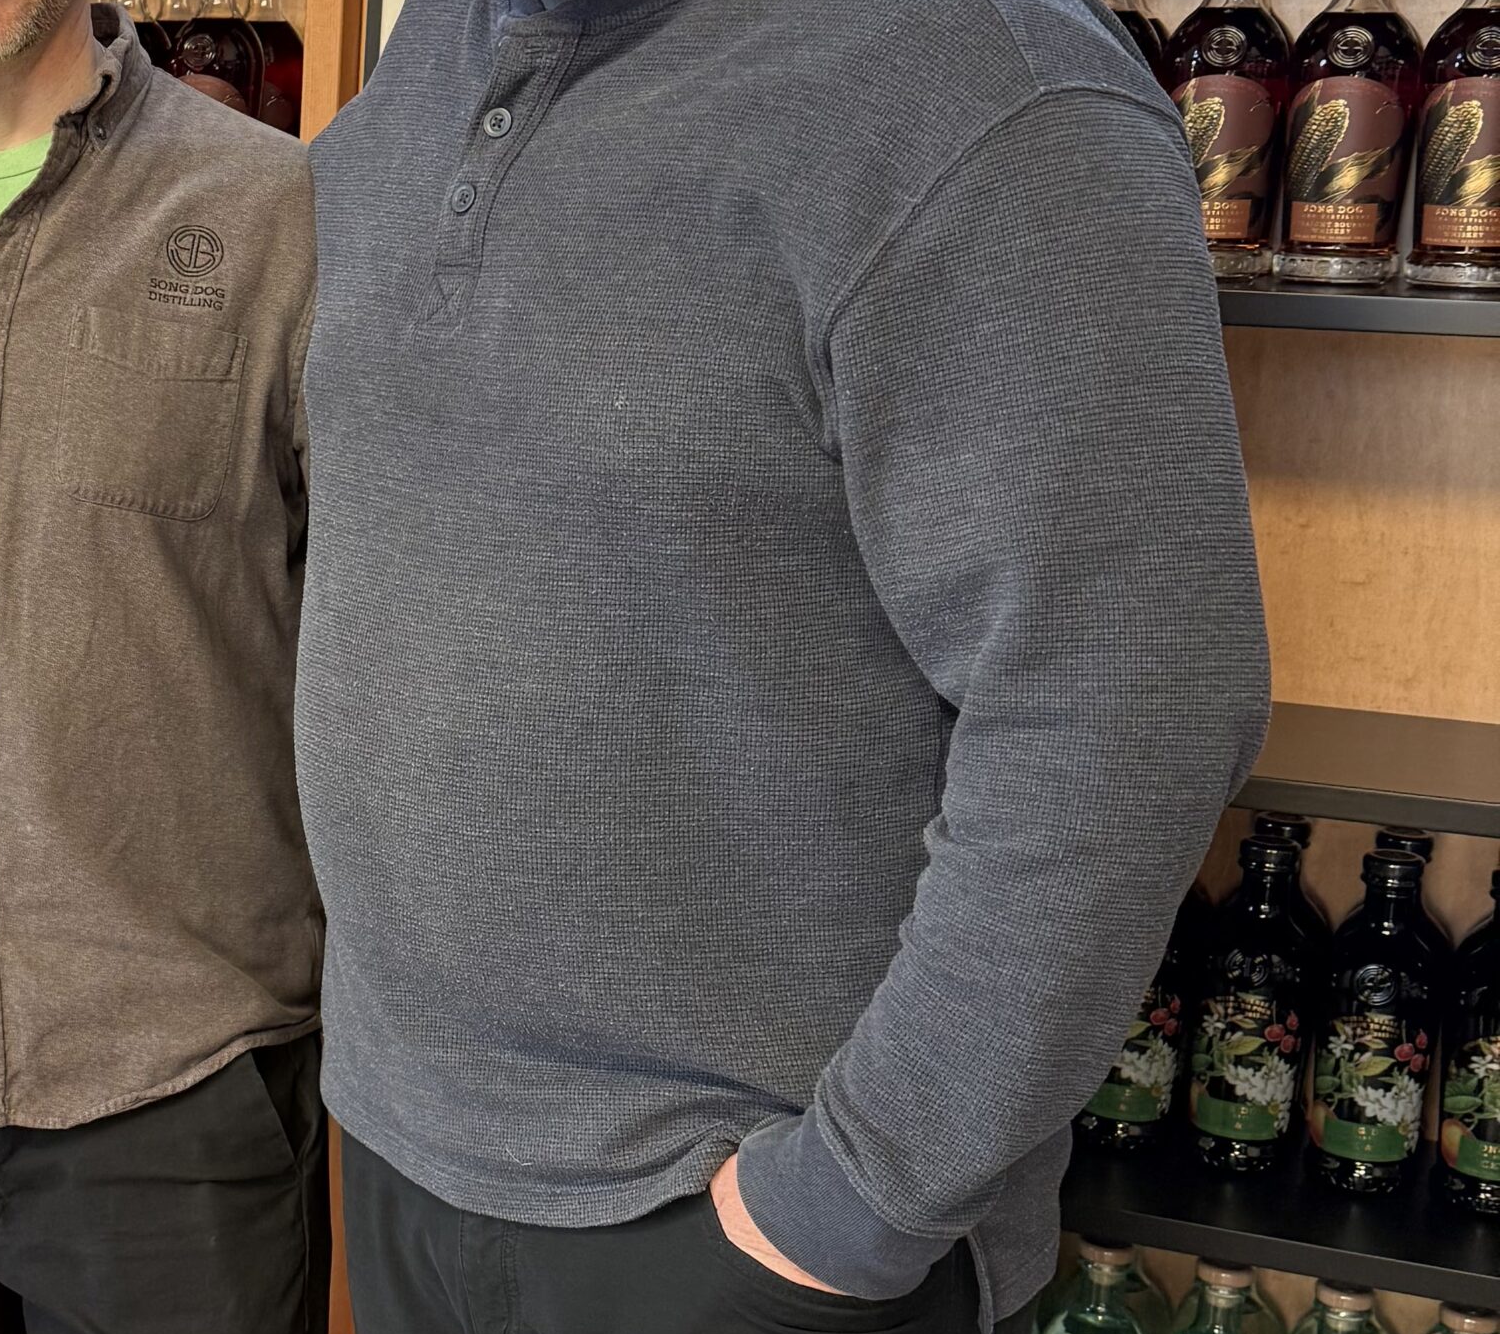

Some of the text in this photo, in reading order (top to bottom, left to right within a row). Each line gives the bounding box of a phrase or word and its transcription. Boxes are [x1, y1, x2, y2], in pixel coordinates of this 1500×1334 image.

[1337, 205, 1364, 214] DOG
[1470, 209, 1498, 217] DOG
[150, 277, 226, 299] SONG DOG
[148, 290, 224, 311] DISTILLING
